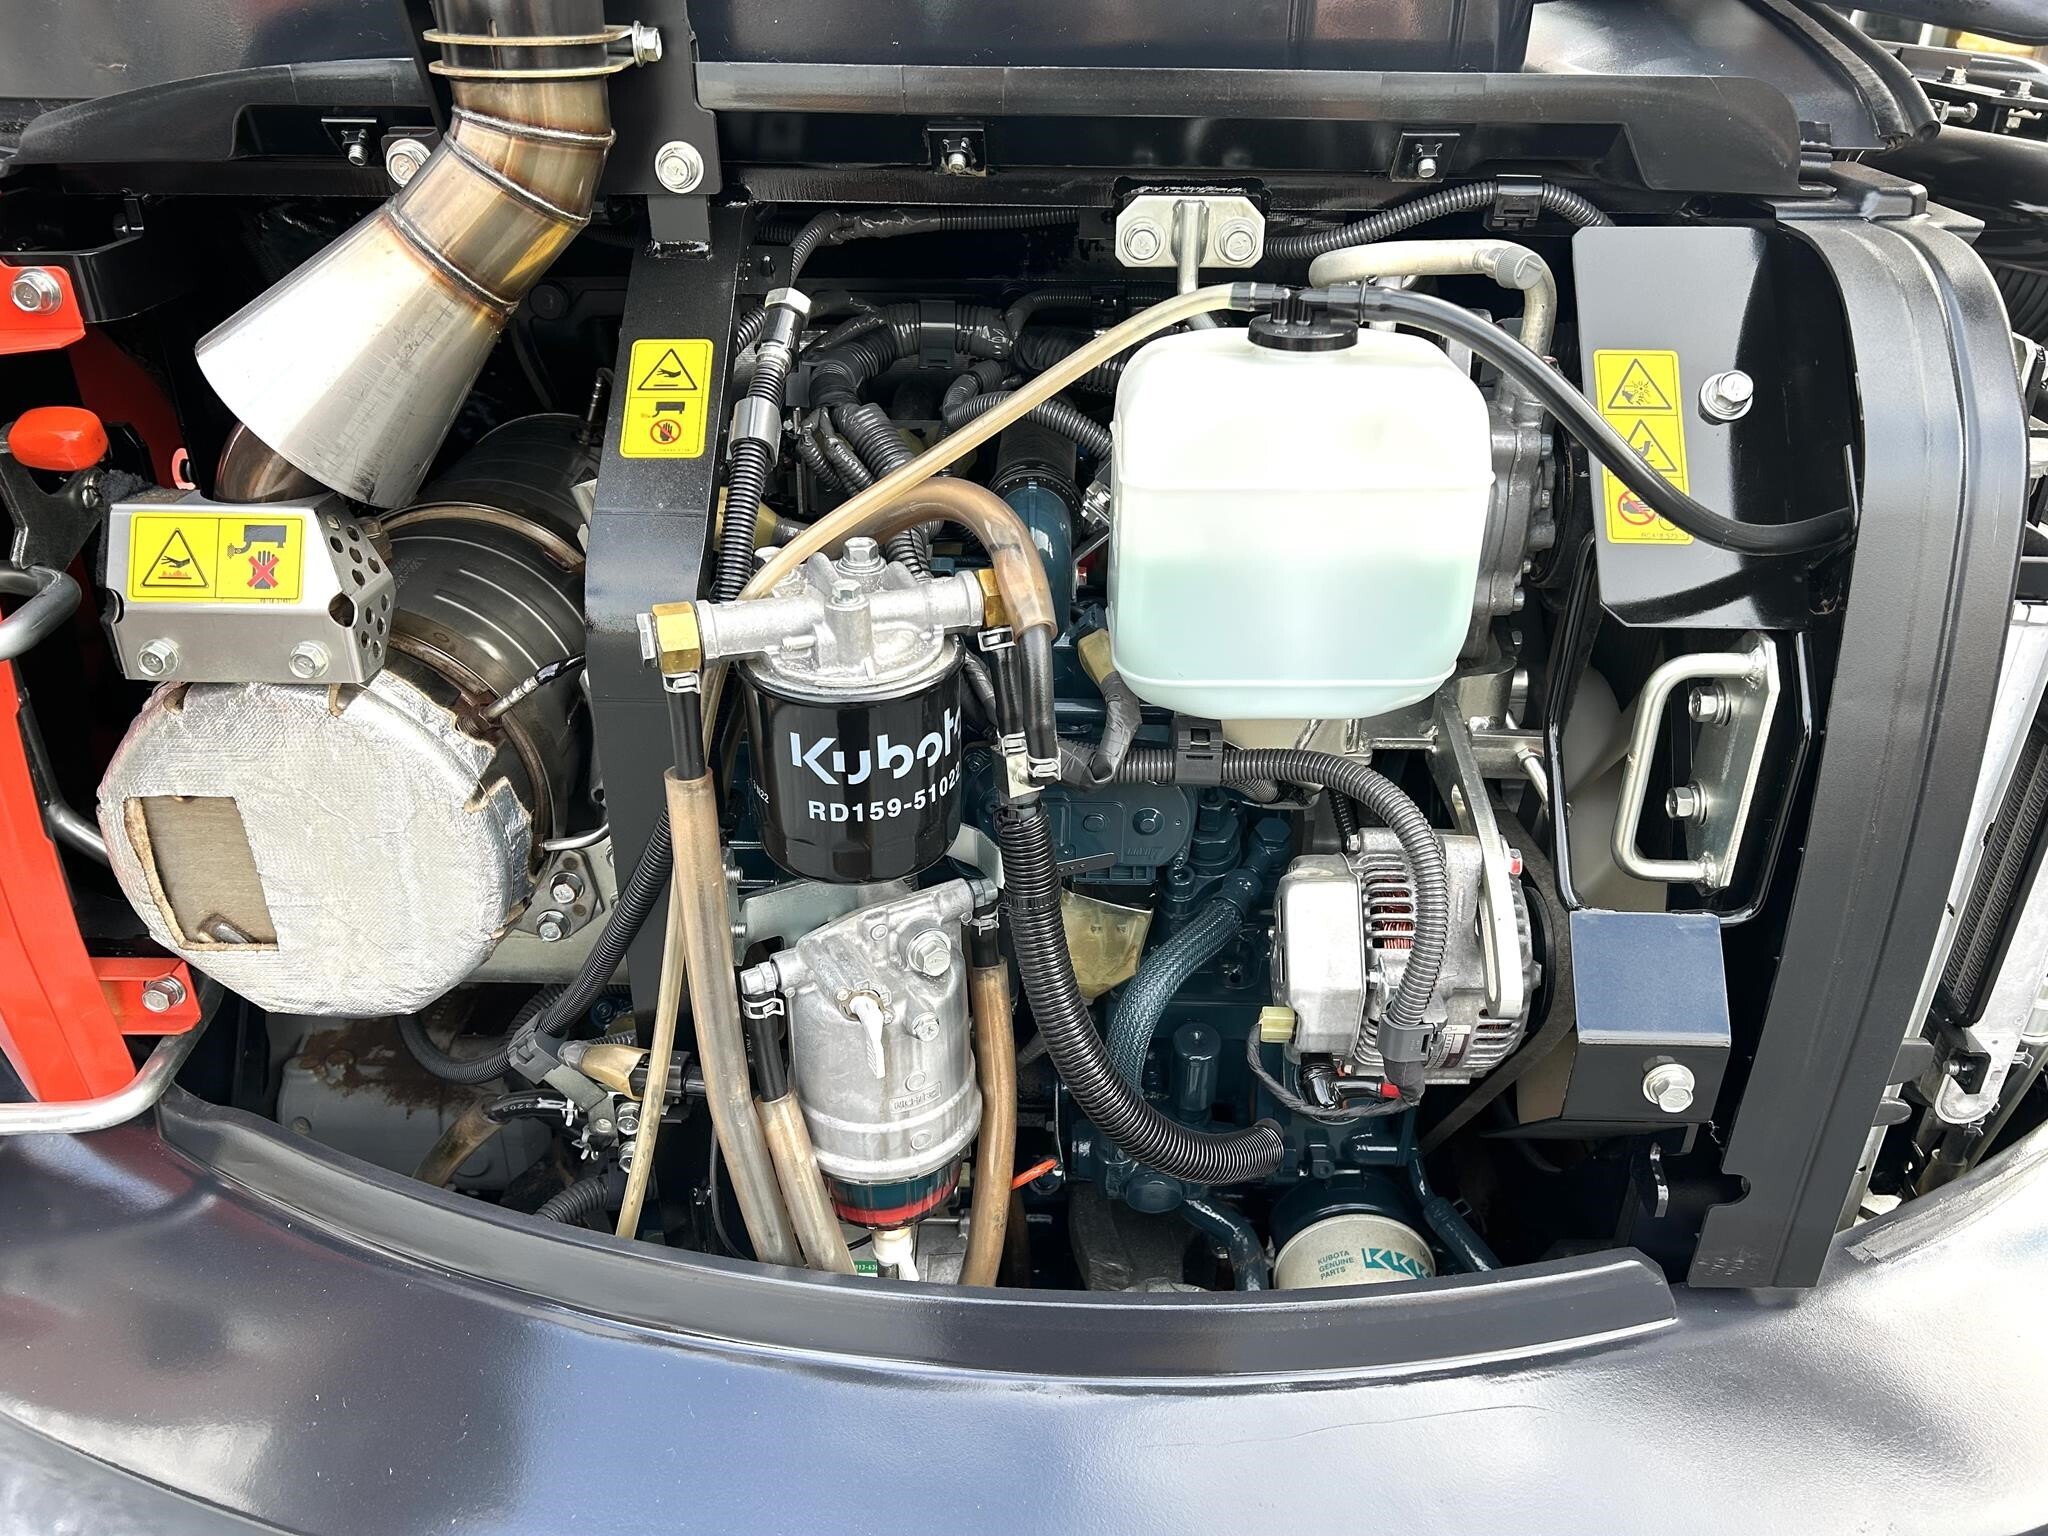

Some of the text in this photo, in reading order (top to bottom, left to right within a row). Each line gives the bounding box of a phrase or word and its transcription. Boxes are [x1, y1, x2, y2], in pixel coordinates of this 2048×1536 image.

[808, 760, 961, 823] RD159-51022
[1317, 1250, 1350, 1265] KUBOTA
[1318, 1256, 1355, 1273] GENUINE
[1320, 1266, 1346, 1281] PARTS
